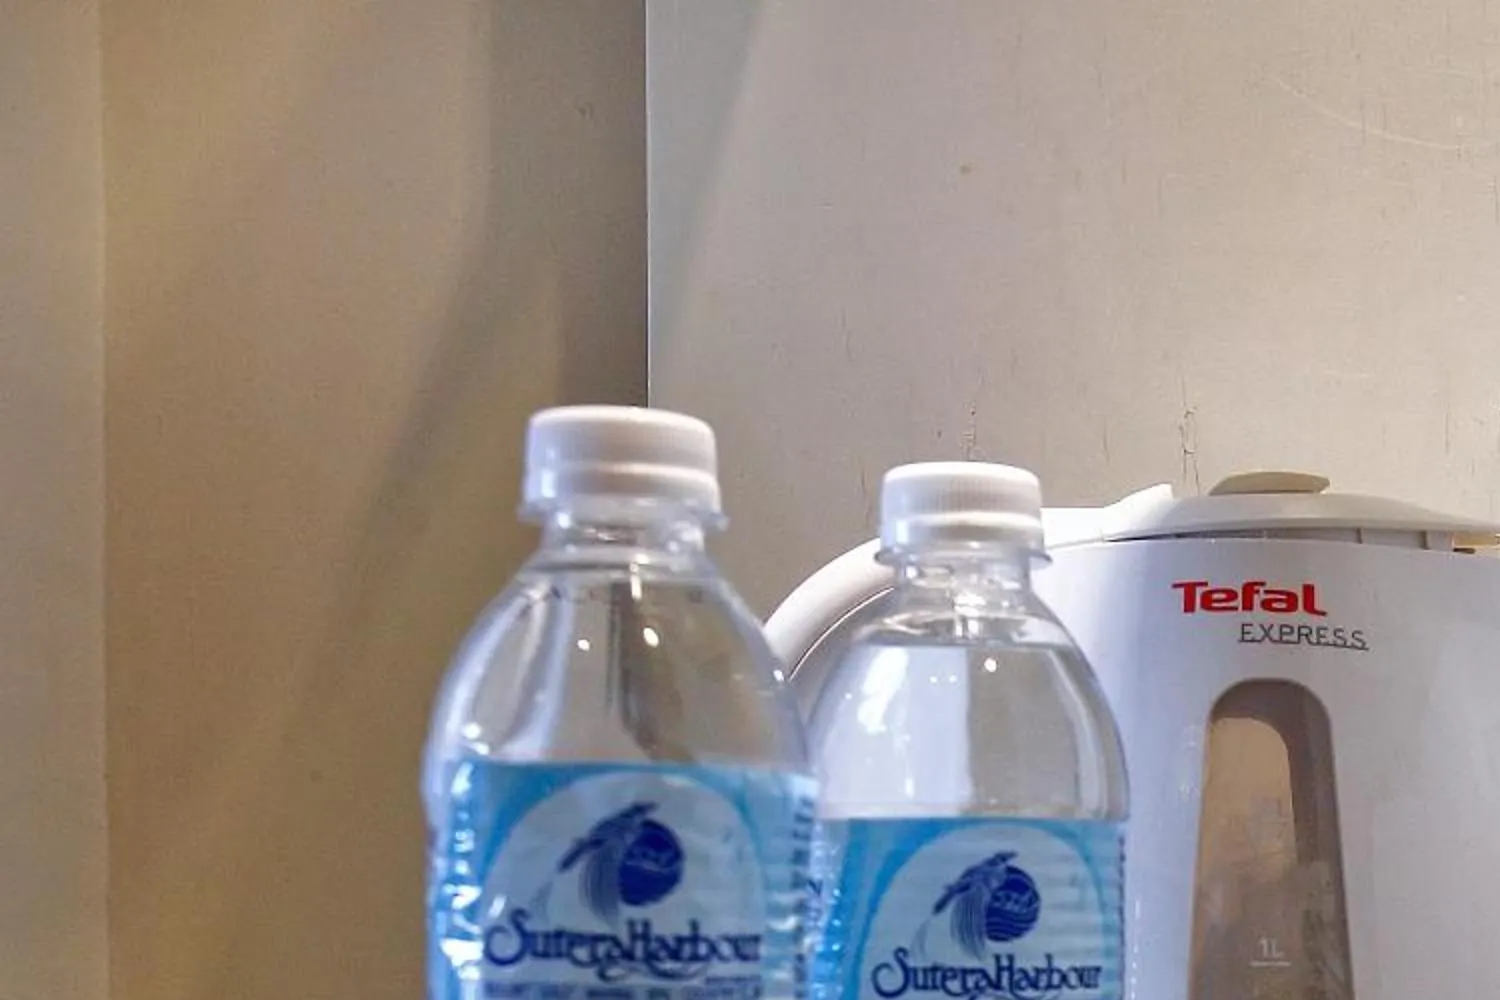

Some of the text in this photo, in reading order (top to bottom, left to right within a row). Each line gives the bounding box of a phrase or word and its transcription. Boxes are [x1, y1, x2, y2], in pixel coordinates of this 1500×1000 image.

[1171, 581, 1328, 616] Tefal
[1238, 623, 1369, 651] EXPRESS
[1258, 937, 1284, 958] 1L
